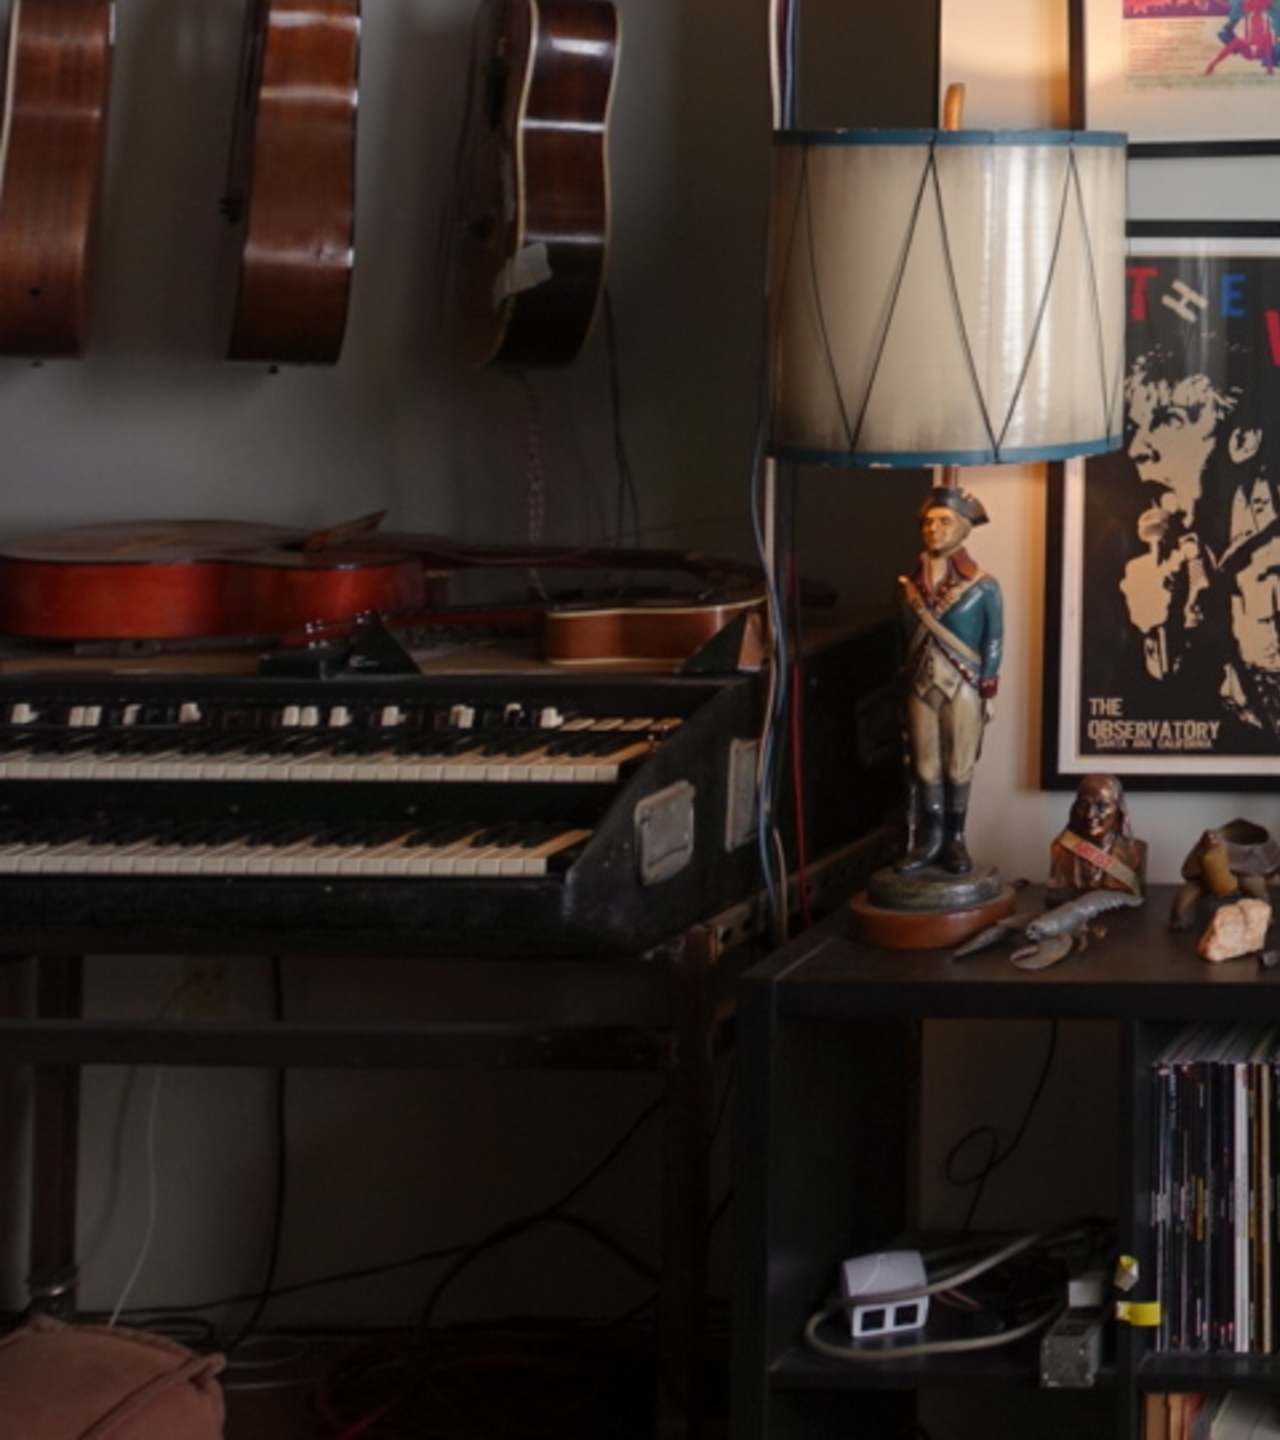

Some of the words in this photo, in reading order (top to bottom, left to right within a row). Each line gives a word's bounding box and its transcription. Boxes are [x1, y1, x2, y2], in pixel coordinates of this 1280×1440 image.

[1125, 266, 1249, 324] THE
[1088, 697, 1123, 716] THE
[1087, 719, 1220, 740] OBSERVATORY
